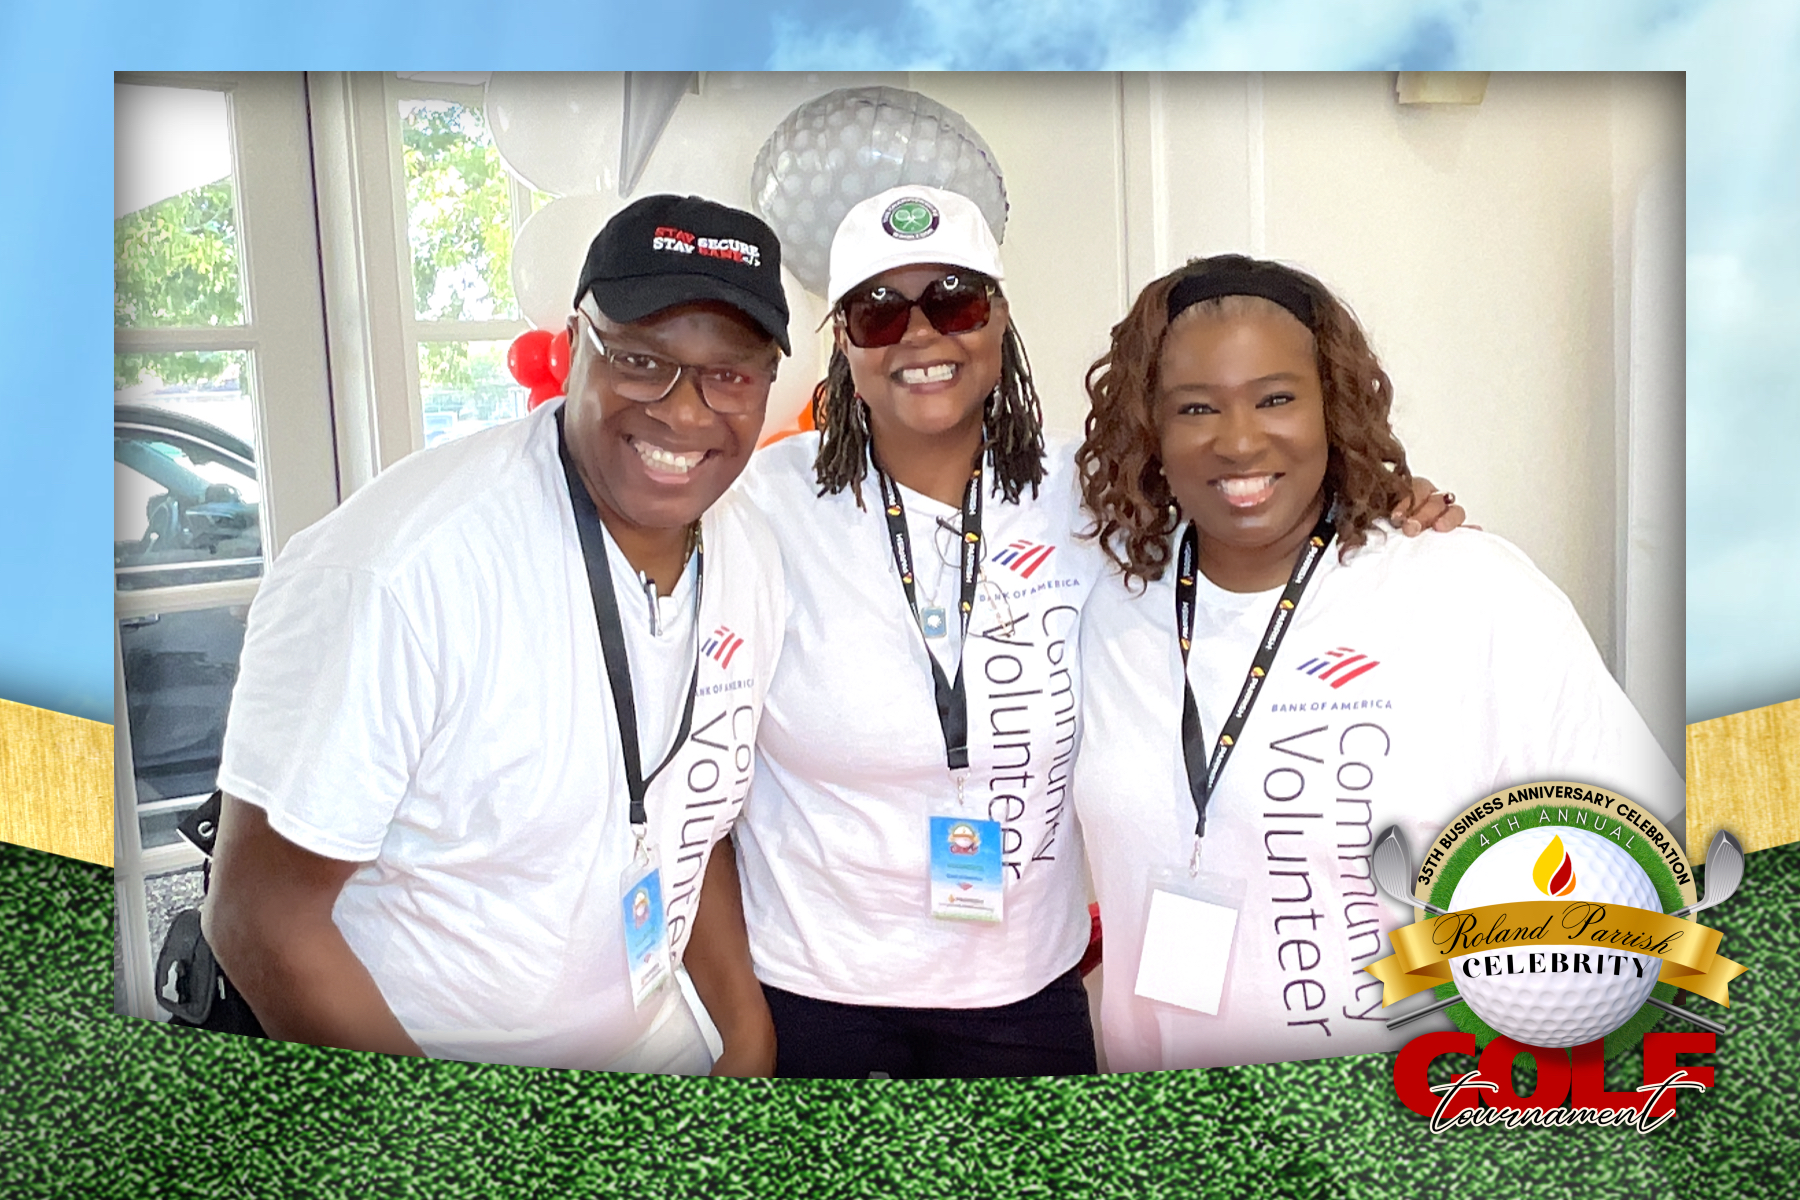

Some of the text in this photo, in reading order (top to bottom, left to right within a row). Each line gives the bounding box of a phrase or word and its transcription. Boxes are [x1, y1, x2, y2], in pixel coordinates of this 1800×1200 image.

[653, 237, 760, 258] STAY SECURE
[966, 543, 976, 583] PARRISH
[1030, 579, 1080, 595] AMERICA
[1271, 699, 1392, 713] BANK OF AMERICA
[982, 613, 1043, 879] Volunteer
[1031, 605, 1079, 862] Community
[1263, 725, 1332, 1037] Volunteer
